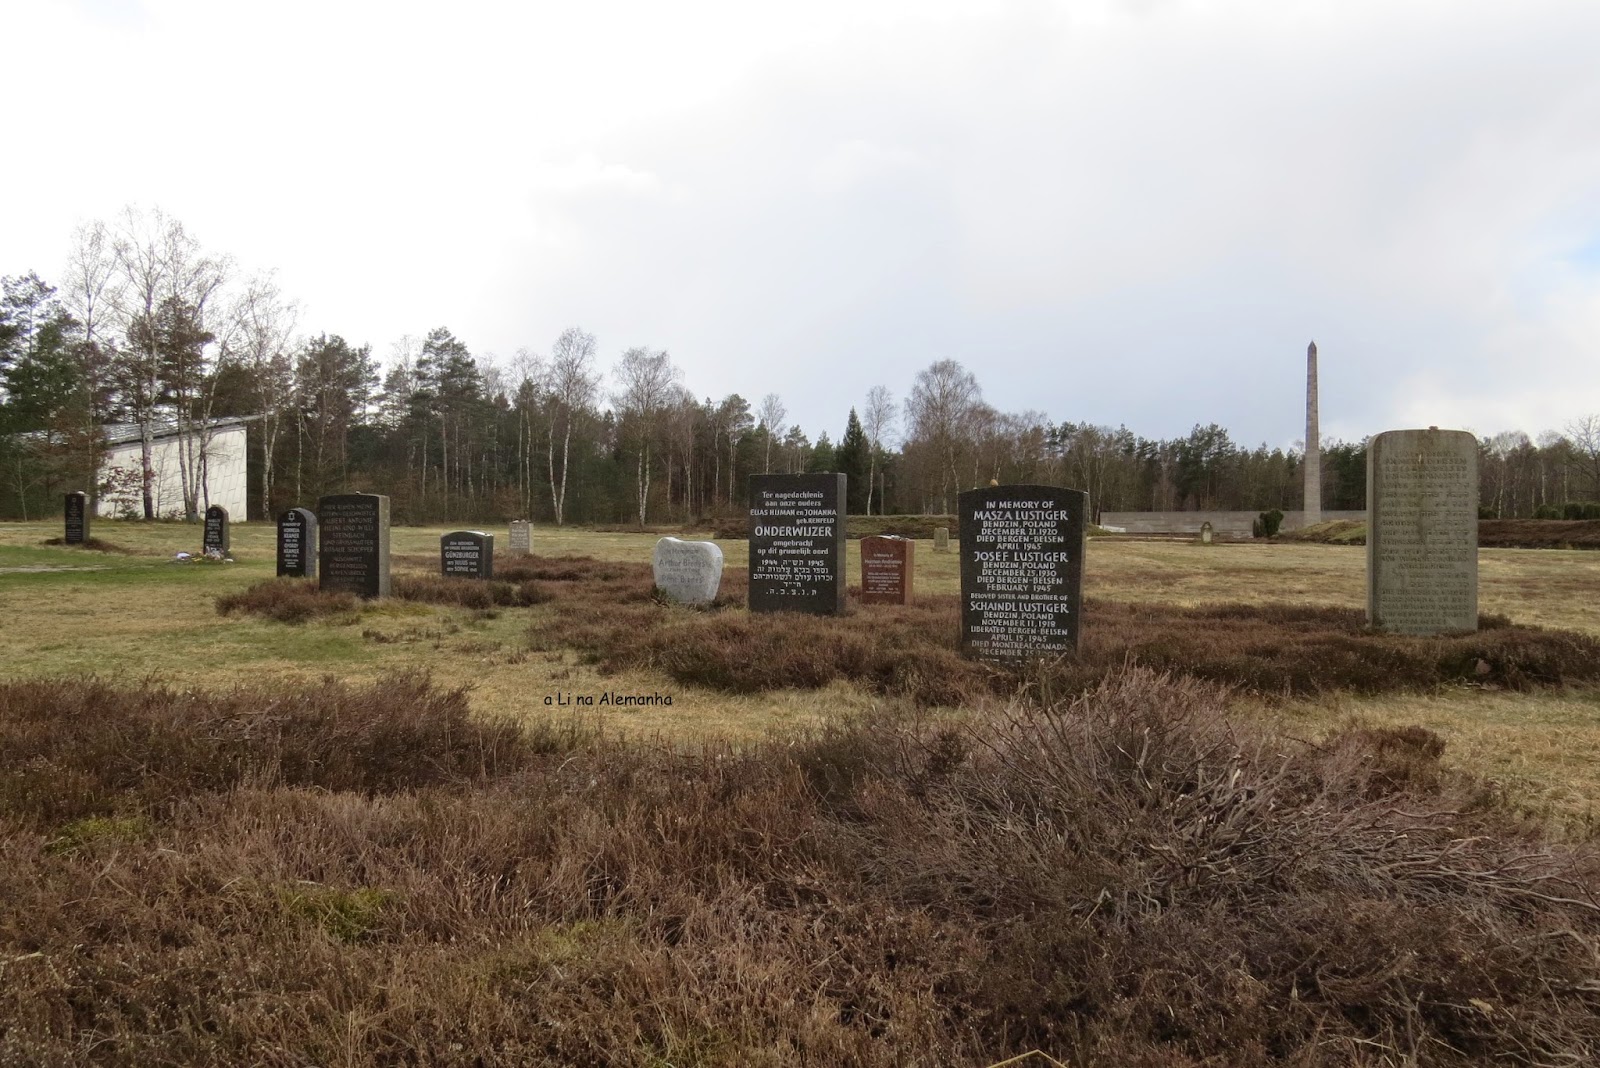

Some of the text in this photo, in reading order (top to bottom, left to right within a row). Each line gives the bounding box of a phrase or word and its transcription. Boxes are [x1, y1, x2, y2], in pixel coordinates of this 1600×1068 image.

[775, 490, 823, 500] nagedachtenis
[999, 501, 1039, 509] MEMORY
[1042, 501, 1054, 509] OF
[973, 510, 1068, 520] MASZA LUSTIGER
[754, 526, 832, 537] ONDERWIJZER
[974, 552, 1068, 562] JOSEF LUSTIGER
[970, 601, 1069, 614] SCHAINDL LUSTIGER
[980, 648, 1022, 656] DECEMBER
